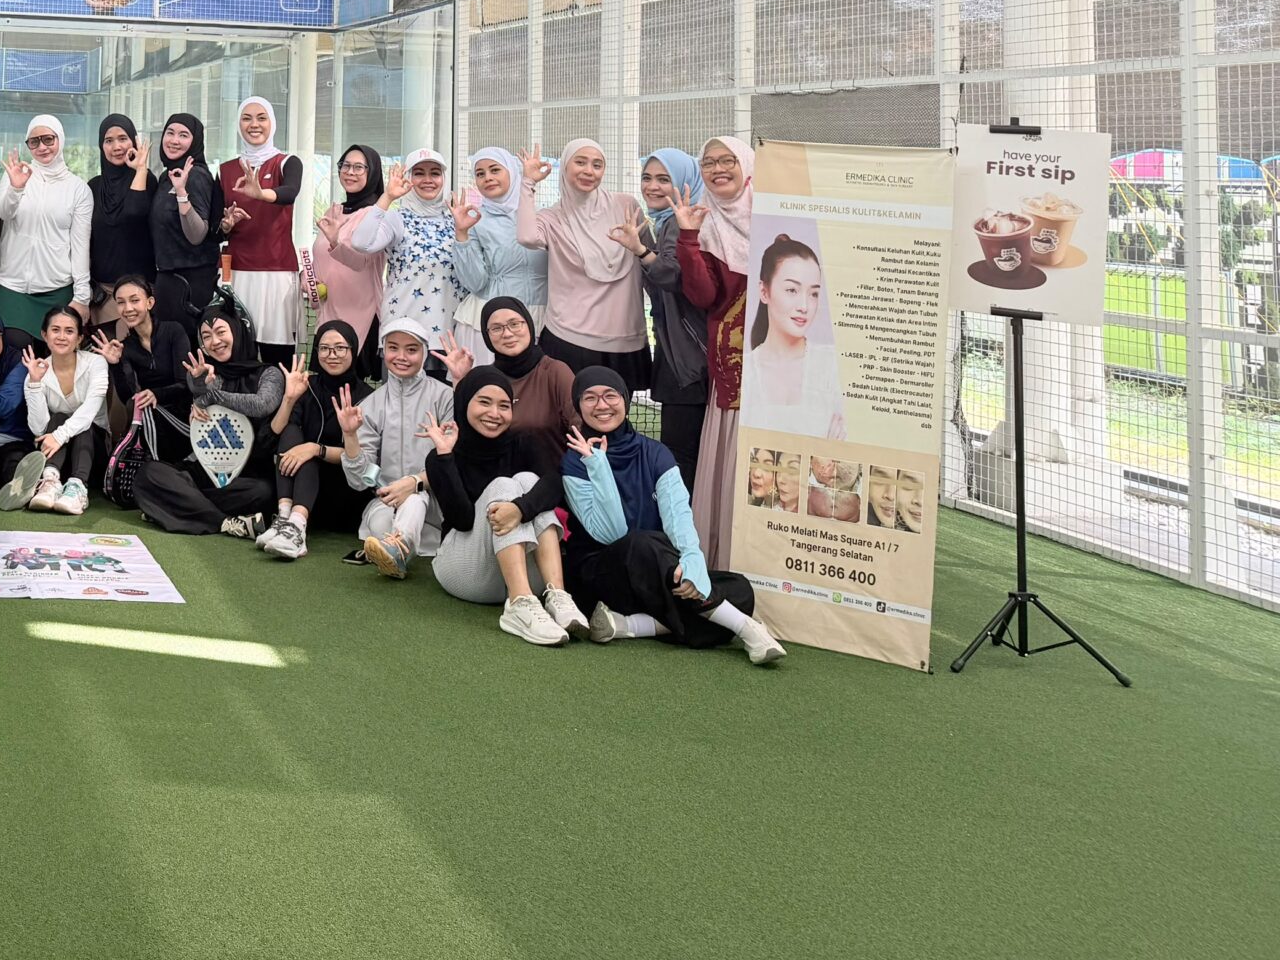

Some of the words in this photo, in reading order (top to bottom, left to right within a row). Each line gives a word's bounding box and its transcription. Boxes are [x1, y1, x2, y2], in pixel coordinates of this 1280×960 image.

[1003, 149, 1031, 161] have
[1035, 153, 1062, 164] your
[845, 172, 886, 183] ERMEDIKA
[888, 175, 914, 185] CLINIC
[986, 161, 1035, 178] First
[1041, 165, 1075, 185] sip
[780, 202, 806, 211] KLINIK
[808, 204, 850, 215] SPESIALIS
[852, 208, 921, 220] KULIT&KELAMIN
[857, 245, 886, 253] Konsultasi
[887, 247, 910, 255] Keluhan
[303, 251, 318, 302] nordicdots
[895, 278, 925, 286] Perawatan
[840, 292, 870, 300] Perawatan
[849, 303, 887, 312] Mencerahkan
[846, 312, 875, 320] Perawatan
[870, 324, 917, 336] Mengencangkan
[869, 335, 912, 345] Menumbuhkan
[913, 340, 935, 348] Rambut
[865, 374, 895, 383] Dermapen
[900, 379, 934, 388] Dermaroller
[871, 385, 889, 393] Listrik
[904, 399, 916, 407] Tahi
[767, 520, 789, 532] Ruko
[791, 525, 818, 538] Melati
[820, 530, 838, 542] Mas
[840, 534, 872, 548] Square
[874, 540, 886, 550] A1
[893, 544, 899, 553] 7
[791, 539, 838, 558] Tangerang
[840, 548, 873, 563] Selatan
[785, 557, 815, 574] 0811
[819, 563, 845, 580] 366
[848, 569, 876, 586] 400
